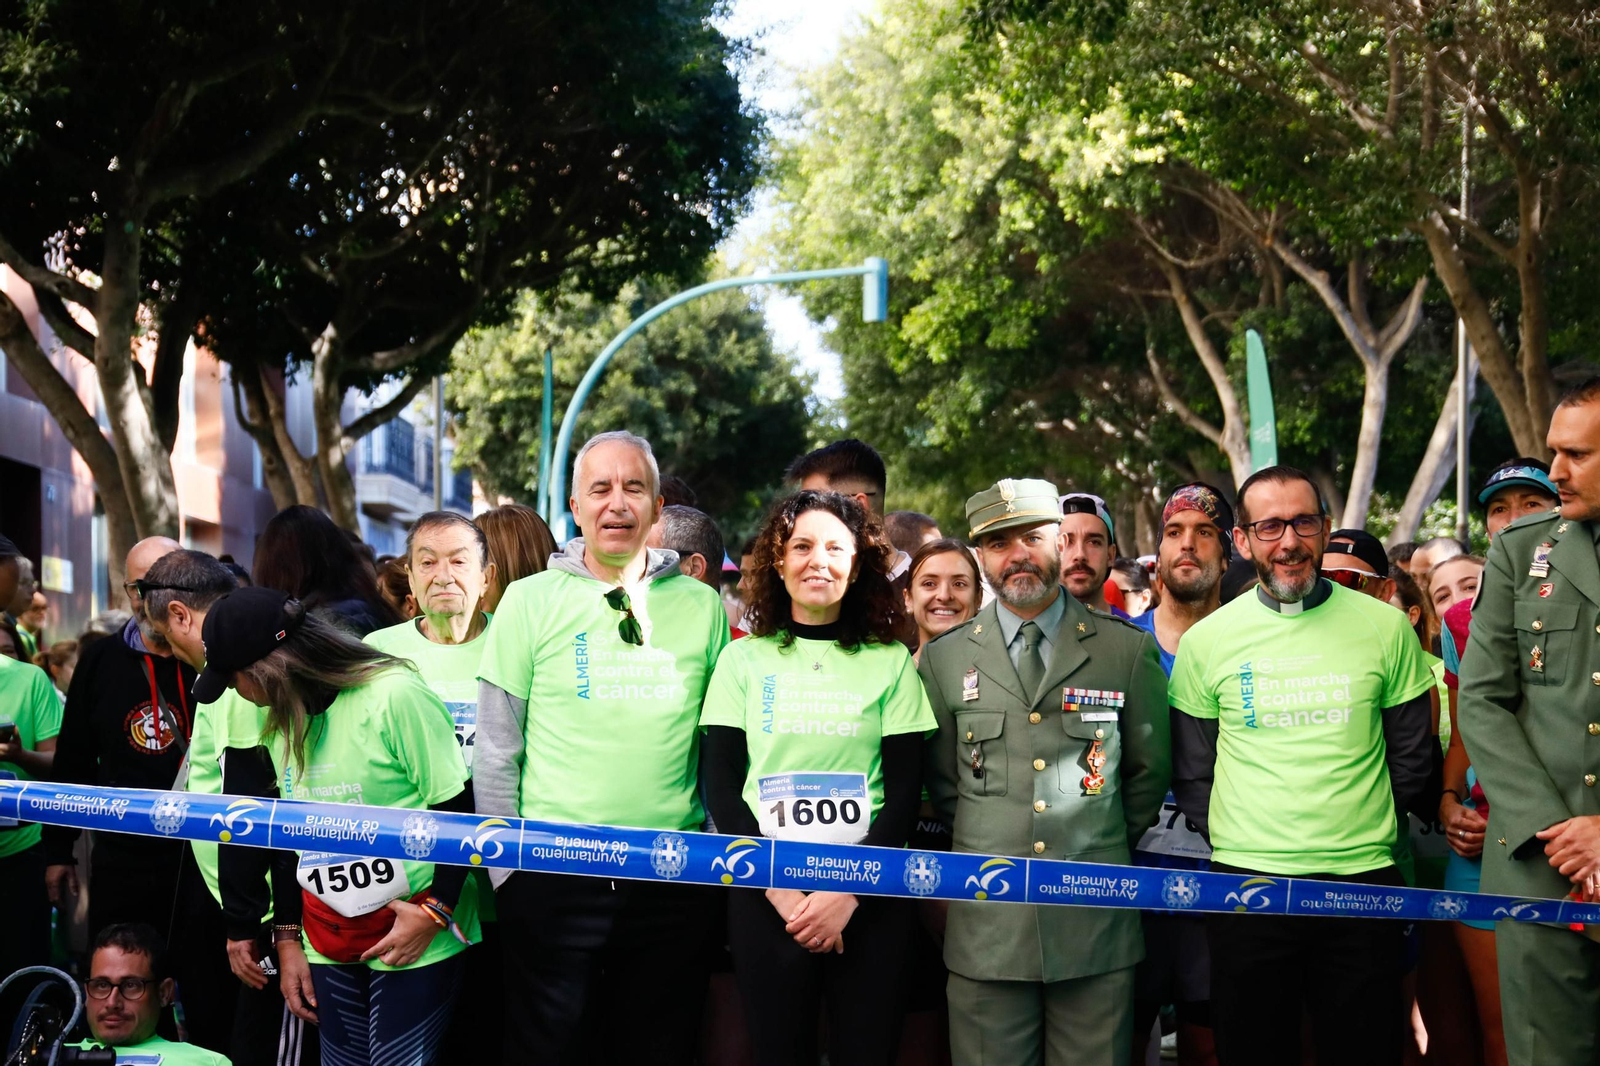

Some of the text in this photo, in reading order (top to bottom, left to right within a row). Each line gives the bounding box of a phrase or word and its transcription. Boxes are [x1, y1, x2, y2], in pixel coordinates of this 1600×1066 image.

[592, 649, 613, 661] En
[572, 631, 590, 700] ALMERÍA
[594, 661, 677, 679] contra el
[595, 679, 679, 700] cáncer
[1258, 672, 1351, 691] En marcha
[761, 674, 777, 734] ALMERÍA
[780, 688, 863, 702] En marcha
[1235, 661, 1259, 729] ALMERÍA
[1260, 684, 1352, 707] contra el
[778, 700, 863, 716] contra el
[777, 714, 862, 738] cáncer
[1261, 707, 1354, 728] cáncer
[311, 782, 363, 798] marcha
[762, 784, 786, 795] contra
[796, 783, 821, 791] cáncer
[30, 798, 127, 821] Ayuntamiento
[112, 798, 131, 808] de
[769, 799, 861, 827] 1600
[305, 815, 380, 831] de Almería
[282, 824, 378, 845] Ayuntamiento
[555, 836, 629, 854] de Almería
[532, 846, 628, 867] Ayuntamiento
[807, 855, 881, 873] de Almería
[307, 858, 395, 895] 1509
[784, 866, 881, 885] Ayuntamiento
[1062, 874, 1139, 889] de Almería
[1039, 884, 1138, 901] Ayuntamiento
[1325, 891, 1404, 905] de Almería
[1300, 899, 1402, 913] Ayuntamiento
